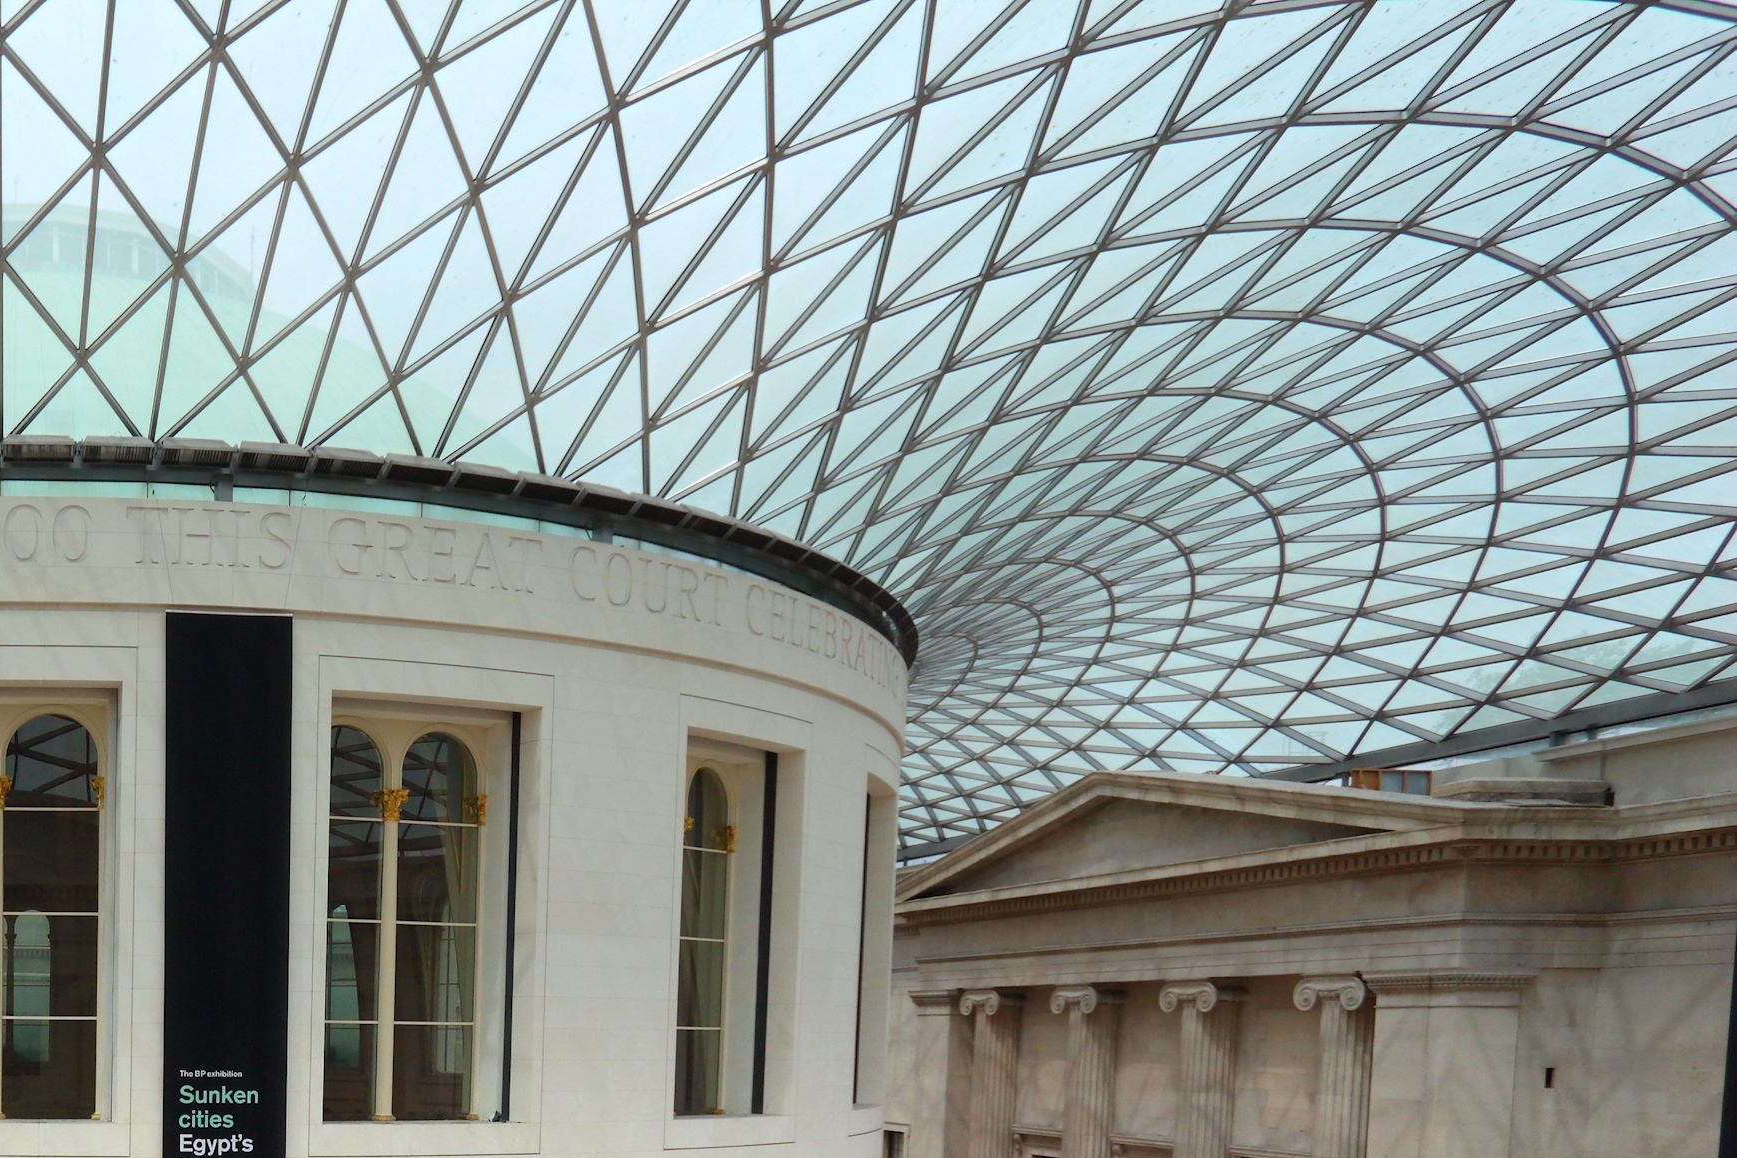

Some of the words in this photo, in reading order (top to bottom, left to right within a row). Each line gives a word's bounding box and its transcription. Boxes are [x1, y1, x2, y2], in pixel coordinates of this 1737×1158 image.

[126, 505, 292, 570] THIS
[326, 517, 544, 595] GREAT
[570, 546, 728, 627] COURT
[179, 1085, 259, 1104] Sunken
[178, 1110, 234, 1128] cities
